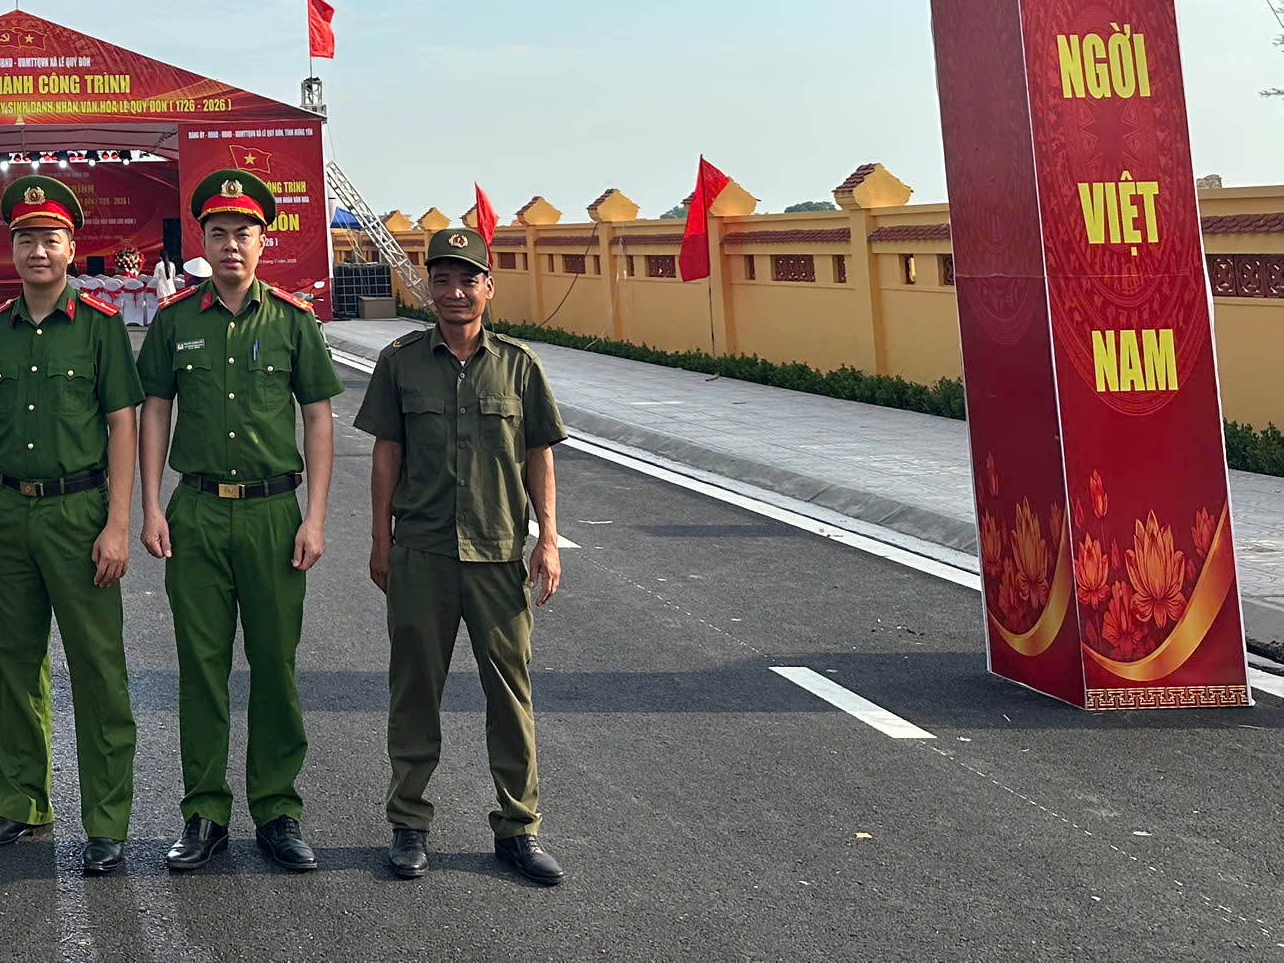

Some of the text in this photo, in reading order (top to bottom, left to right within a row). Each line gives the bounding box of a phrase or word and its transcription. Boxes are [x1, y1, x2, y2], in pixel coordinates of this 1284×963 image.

[1057, 23, 1150, 99] NGỜI
[38, 72, 80, 94] CÔNG
[85, 72, 130, 93] TRÌNH
[7, 101, 28, 114] SINH
[31, 101, 53, 114] DANH
[175, 100, 195, 112] 1726
[203, 99, 226, 111] 2026
[267, 180, 282, 193] ÔNG
[1078, 171, 1159, 256] VIỆT
[1092, 329, 1178, 392] NAM
